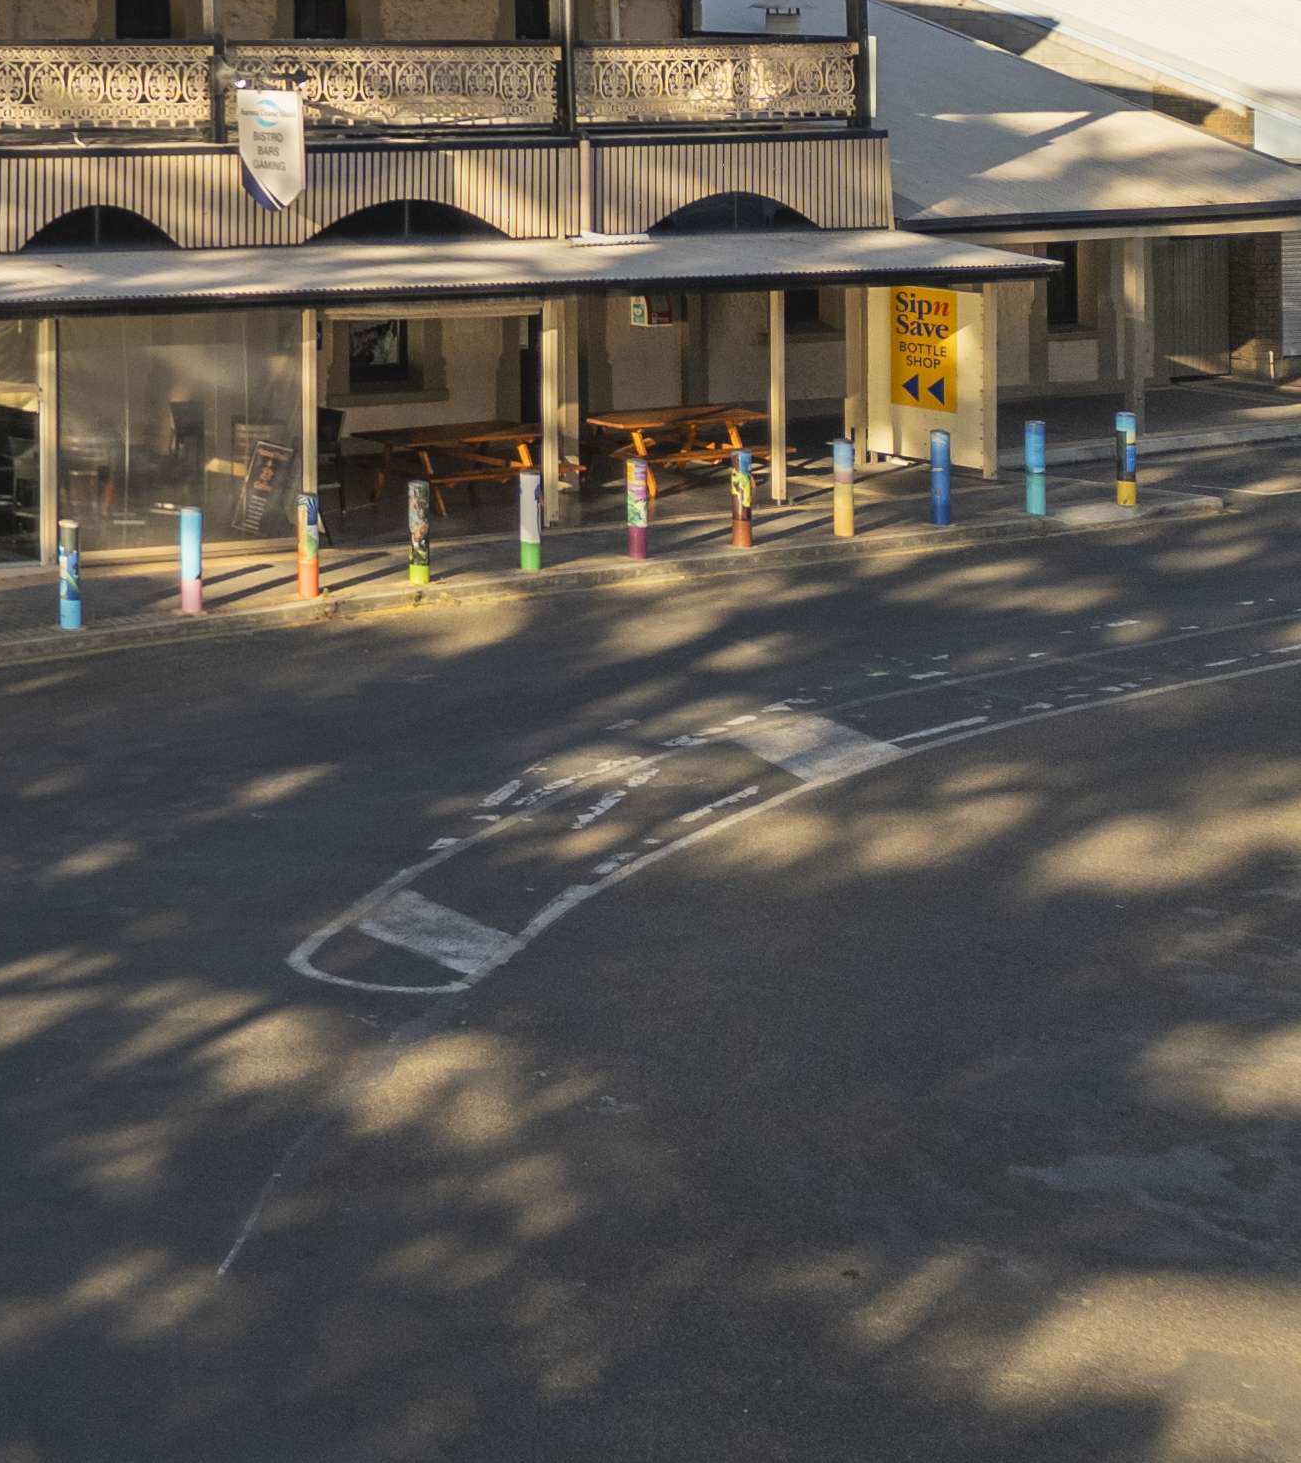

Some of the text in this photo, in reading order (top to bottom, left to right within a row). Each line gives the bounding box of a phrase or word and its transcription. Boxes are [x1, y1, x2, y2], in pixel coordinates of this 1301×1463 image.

[253, 131, 284, 143] BISTRO
[257, 145, 280, 157] BARS
[252, 159, 286, 171] GAMING
[896, 314, 950, 340] Save
[899, 341, 947, 357] BOTTLE
[906, 355, 941, 369] SHOP
